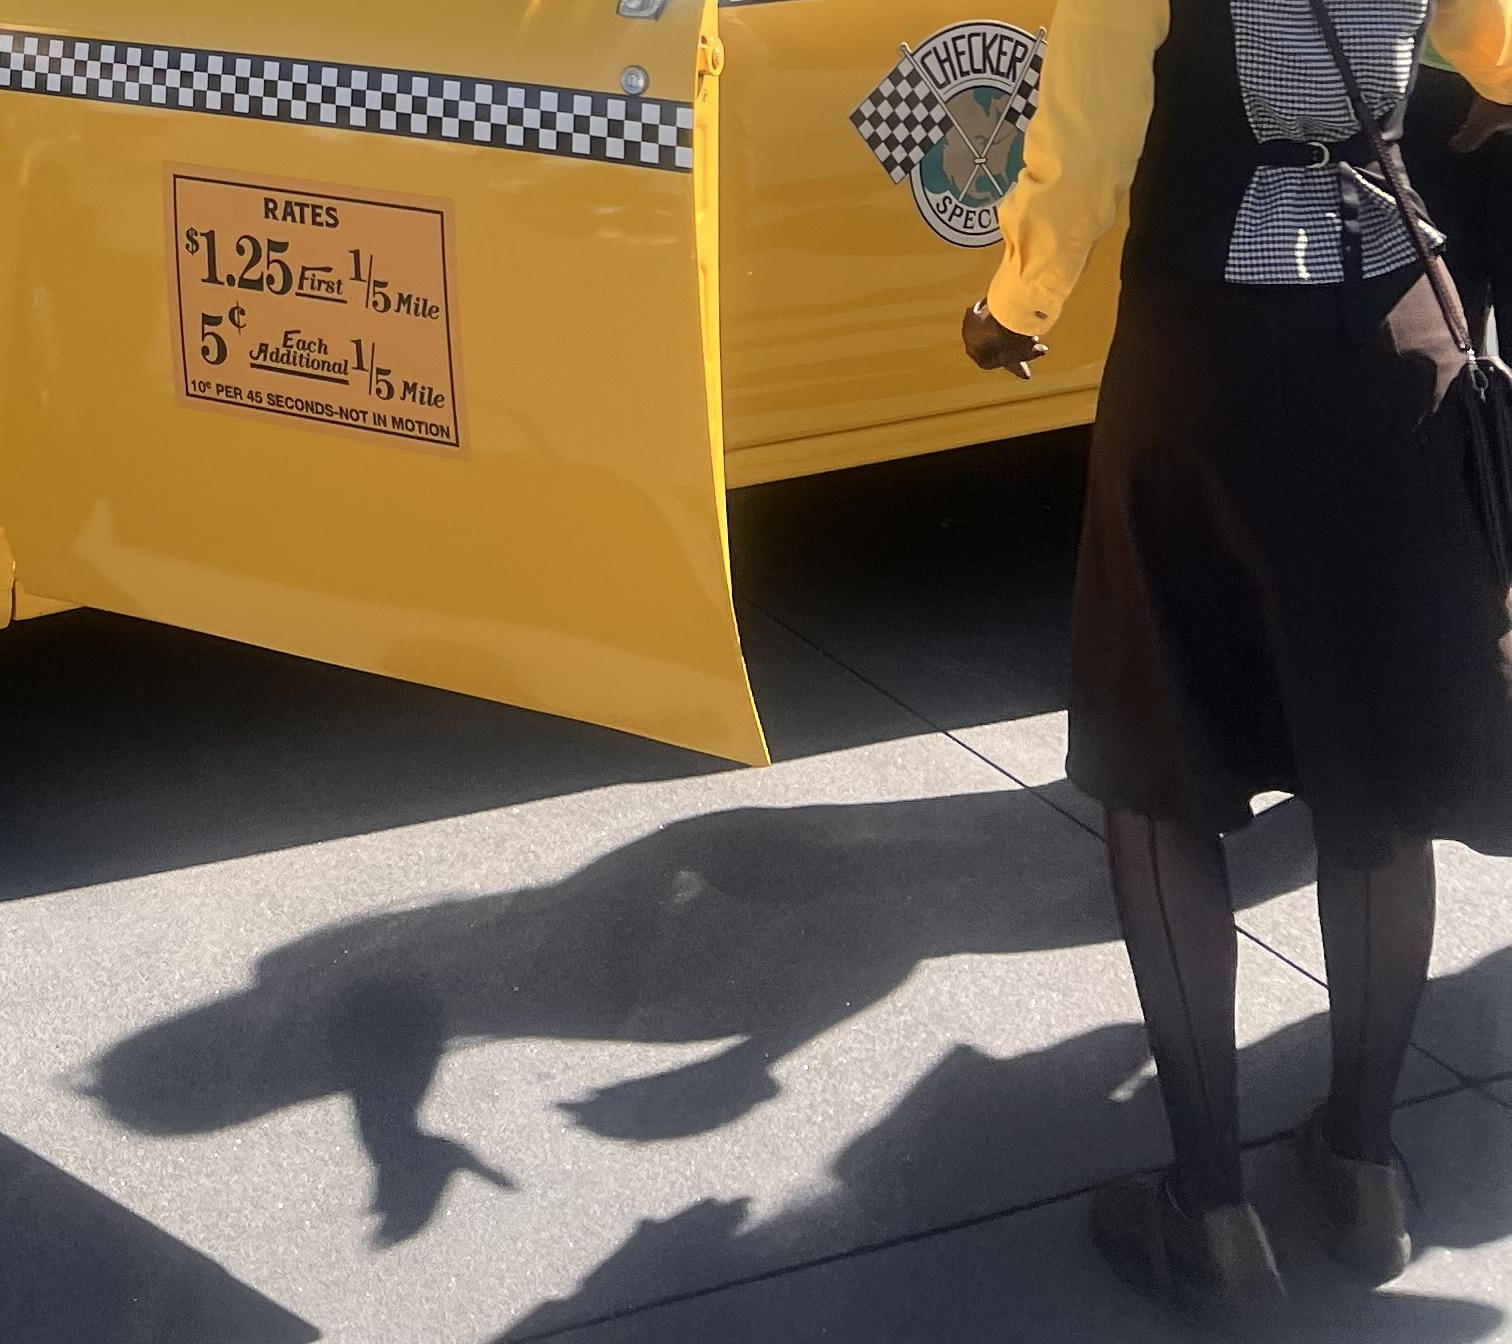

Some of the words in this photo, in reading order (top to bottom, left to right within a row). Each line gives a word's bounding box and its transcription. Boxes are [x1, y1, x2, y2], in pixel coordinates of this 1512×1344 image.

[920, 31, 1029, 89] CHECKER
[264, 197, 339, 229] RATES
[936, 195, 1001, 230] SPECI
[185, 225, 294, 296] $1.25
[297, 265, 344, 295] First
[393, 292, 441, 321] Mile
[201, 301, 248, 365] 5¢
[282, 329, 329, 355] Each
[249, 342, 349, 376] Additional
[399, 381, 446, 409] Mile
[216, 386, 243, 400] PER
[247, 389, 263, 404] 45
[373, 412, 388, 428] IN
[391, 416, 451, 440] MOTION
